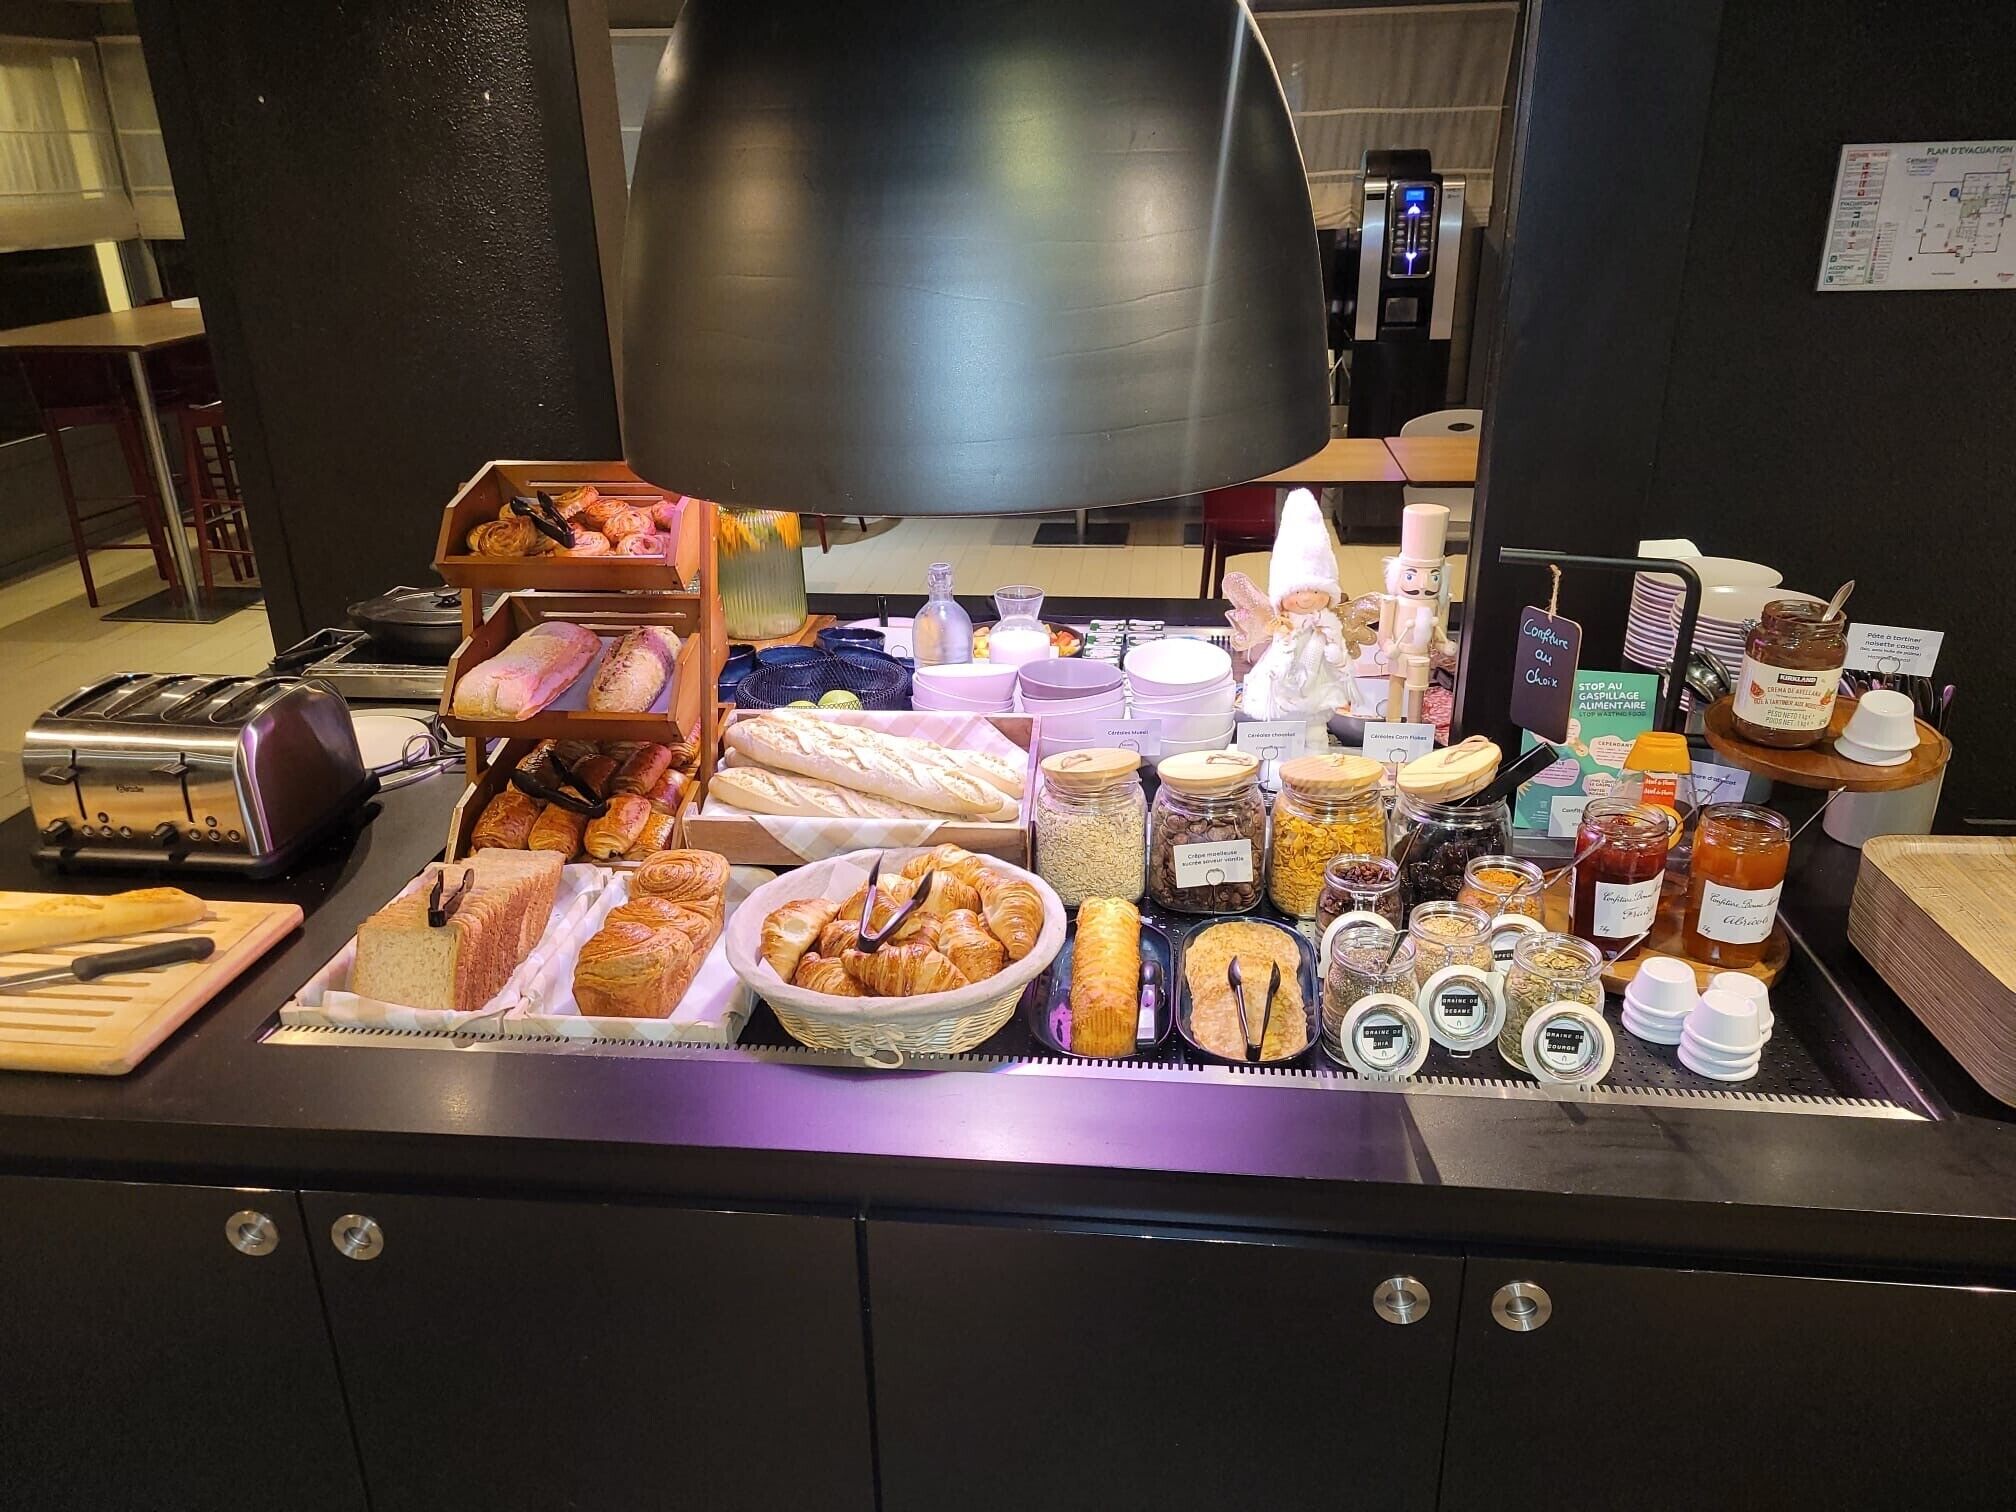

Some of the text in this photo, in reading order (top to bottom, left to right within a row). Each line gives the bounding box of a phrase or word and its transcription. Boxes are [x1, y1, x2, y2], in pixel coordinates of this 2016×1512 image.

[1926, 147, 1949, 155] PLAN
[1523, 618, 1569, 650] Confiture
[1893, 635, 1922, 643] tartiner
[1865, 640, 1920, 651] noisette cacao
[1535, 649, 1553, 666] au
[1525, 667, 1558, 688] Choix
[1779, 673, 1817, 683] KIRKLAND
[1578, 682, 1623, 691] STOP AU
[1767, 686, 1787, 694] CREMA
[1579, 691, 1640, 701] GASPILLAGE
[1578, 701, 1647, 710] ALIMENTAIRE
[1767, 709, 1782, 718] PESO
[1783, 711, 1798, 719] NETO
[1187, 849, 1238, 860] Crêpe moelleuse
[1181, 859, 1202, 867] sucrée
[1202, 857, 1223, 865] saveur
[1709, 893, 1740, 907] Confiture
[1547, 1043, 1576, 1051] COURGE
